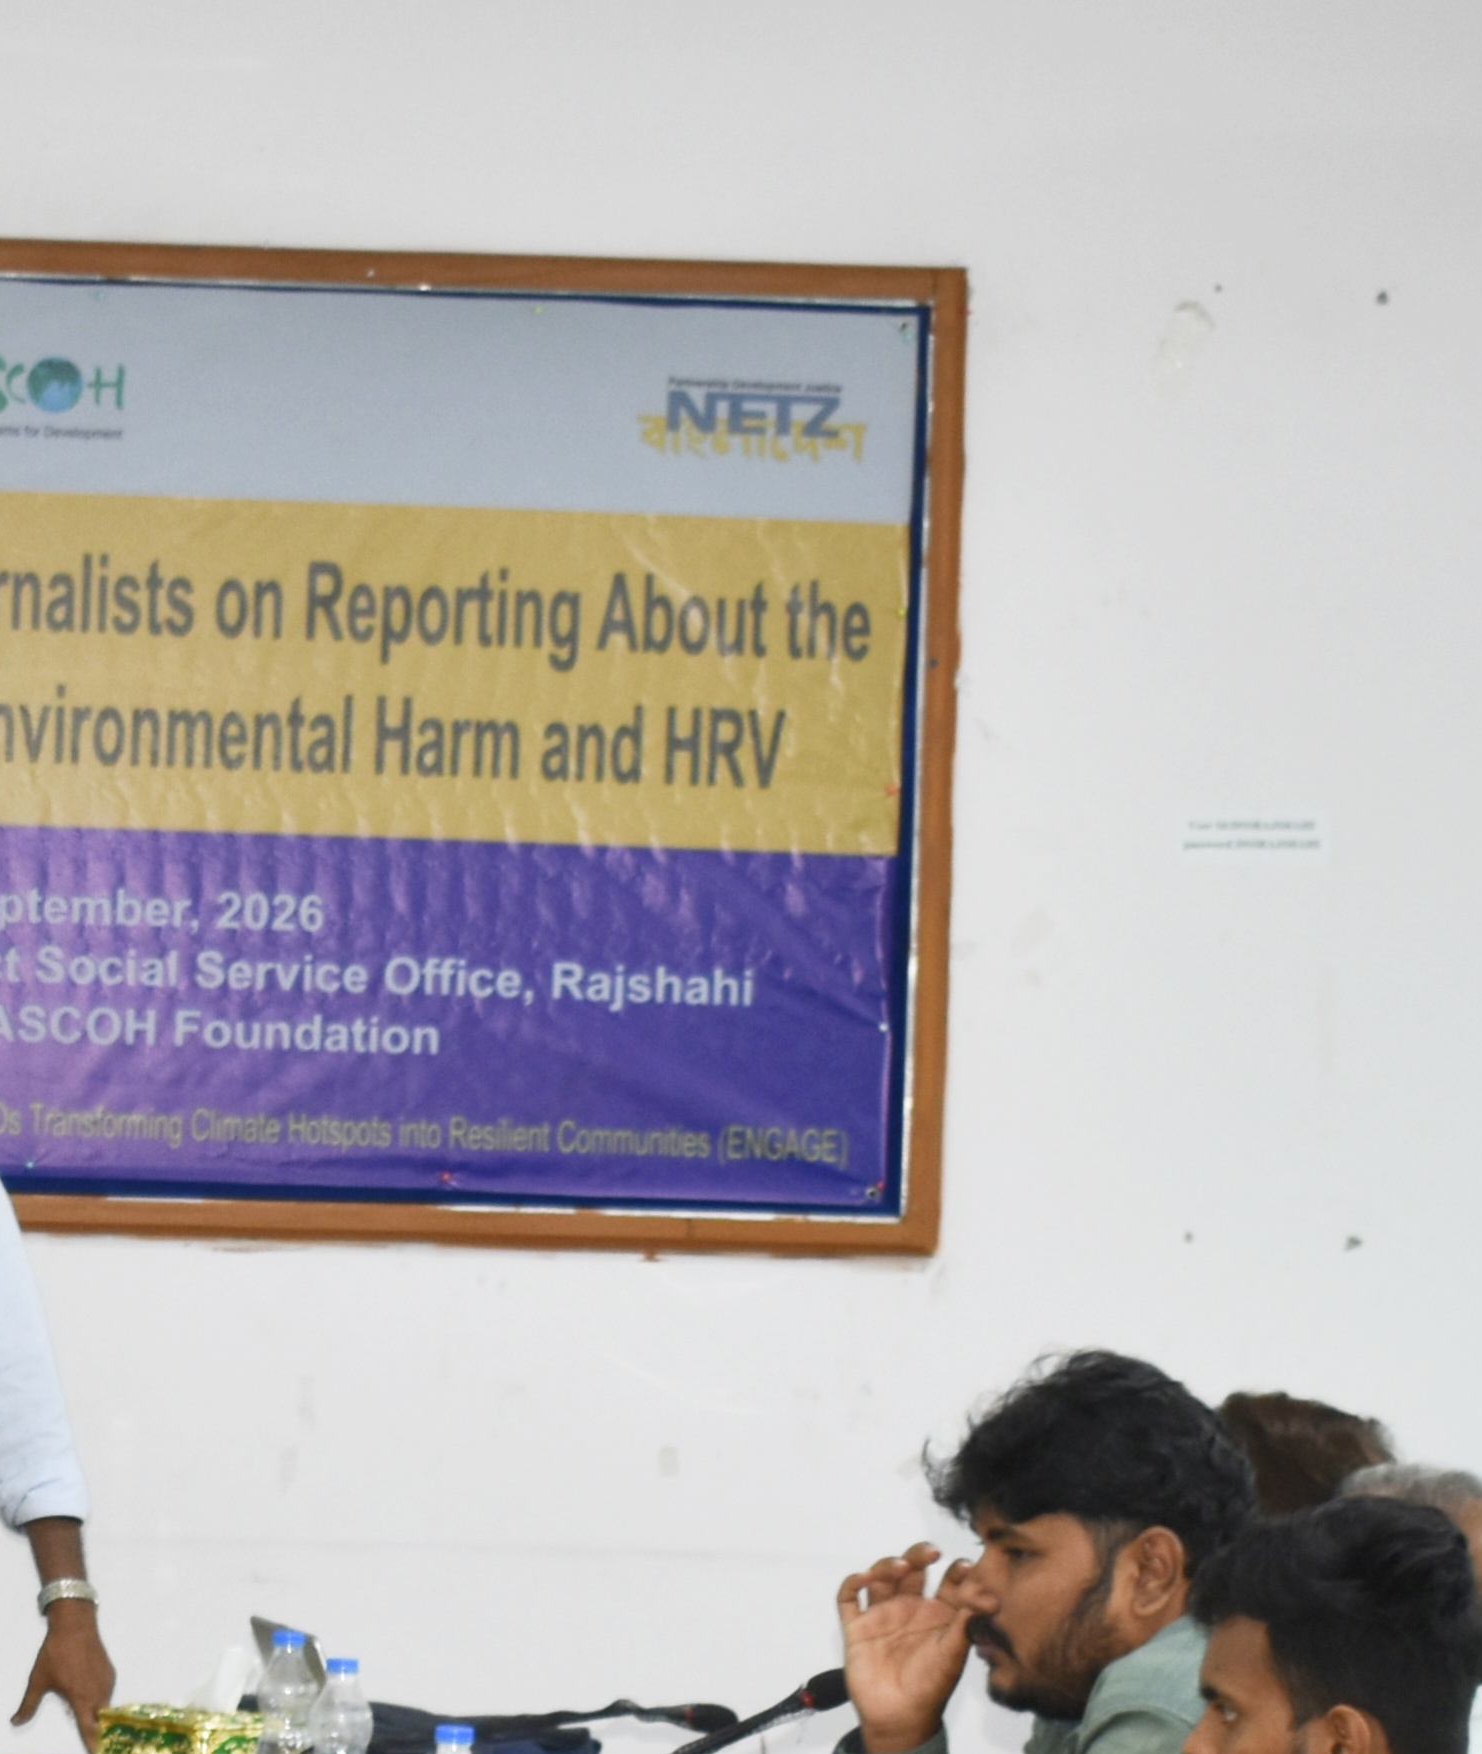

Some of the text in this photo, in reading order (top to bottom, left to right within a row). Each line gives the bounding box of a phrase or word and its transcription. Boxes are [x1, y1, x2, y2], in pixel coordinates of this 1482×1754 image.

[667, 390, 841, 438] NETZ
[216, 580, 282, 641] on
[305, 559, 580, 672] Reporting
[598, 571, 767, 660] About
[786, 579, 872, 663] the
[374, 692, 521, 782] Harm
[542, 705, 642, 787] and
[664, 705, 788, 791] HRV
[215, 890, 325, 936] 2026
[33, 943, 181, 994] Social
[194, 950, 369, 999] Service
[382, 954, 535, 1008] Office,
[550, 959, 756, 1014] Rajshahi
[172, 1008, 440, 1057] Foundation
[30, 1102, 183, 1149] Transforming
[191, 1107, 281, 1146] Climate
[288, 1112, 392, 1153] Hotspots
[399, 1116, 442, 1150] into
[449, 1115, 550, 1153] Resilient
[557, 1119, 712, 1159] Communities
[718, 1124, 850, 1168] (ENGAGE)
